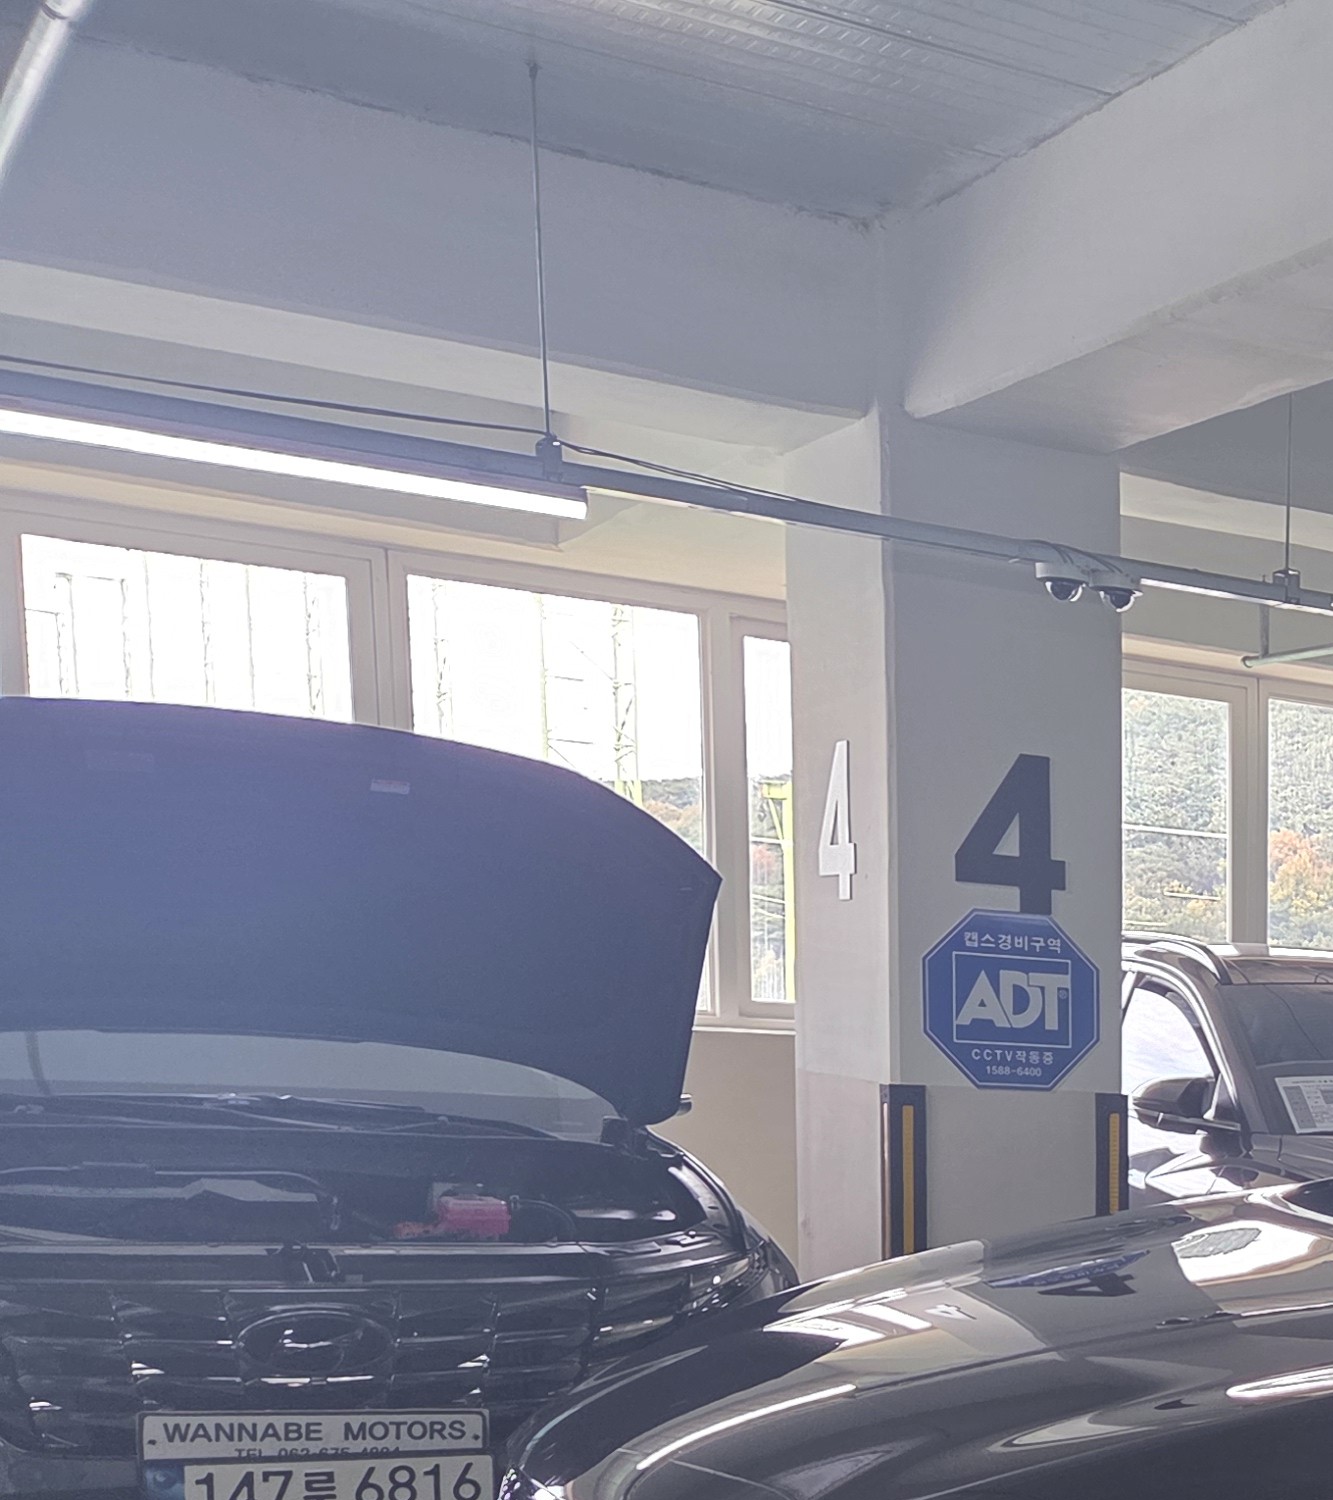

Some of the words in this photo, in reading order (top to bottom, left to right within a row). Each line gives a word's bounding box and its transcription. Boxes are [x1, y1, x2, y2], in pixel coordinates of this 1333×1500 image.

[818, 739, 857, 901] 4
[954, 753, 1066, 914] 4
[964, 931, 1061, 954] 캡스경비구역
[955, 969, 1070, 1030] ADT
[985, 1065, 1042, 1077] 1588-6400
[163, 1421, 323, 1443] WANNABE
[344, 1420, 466, 1441] MOTORS
